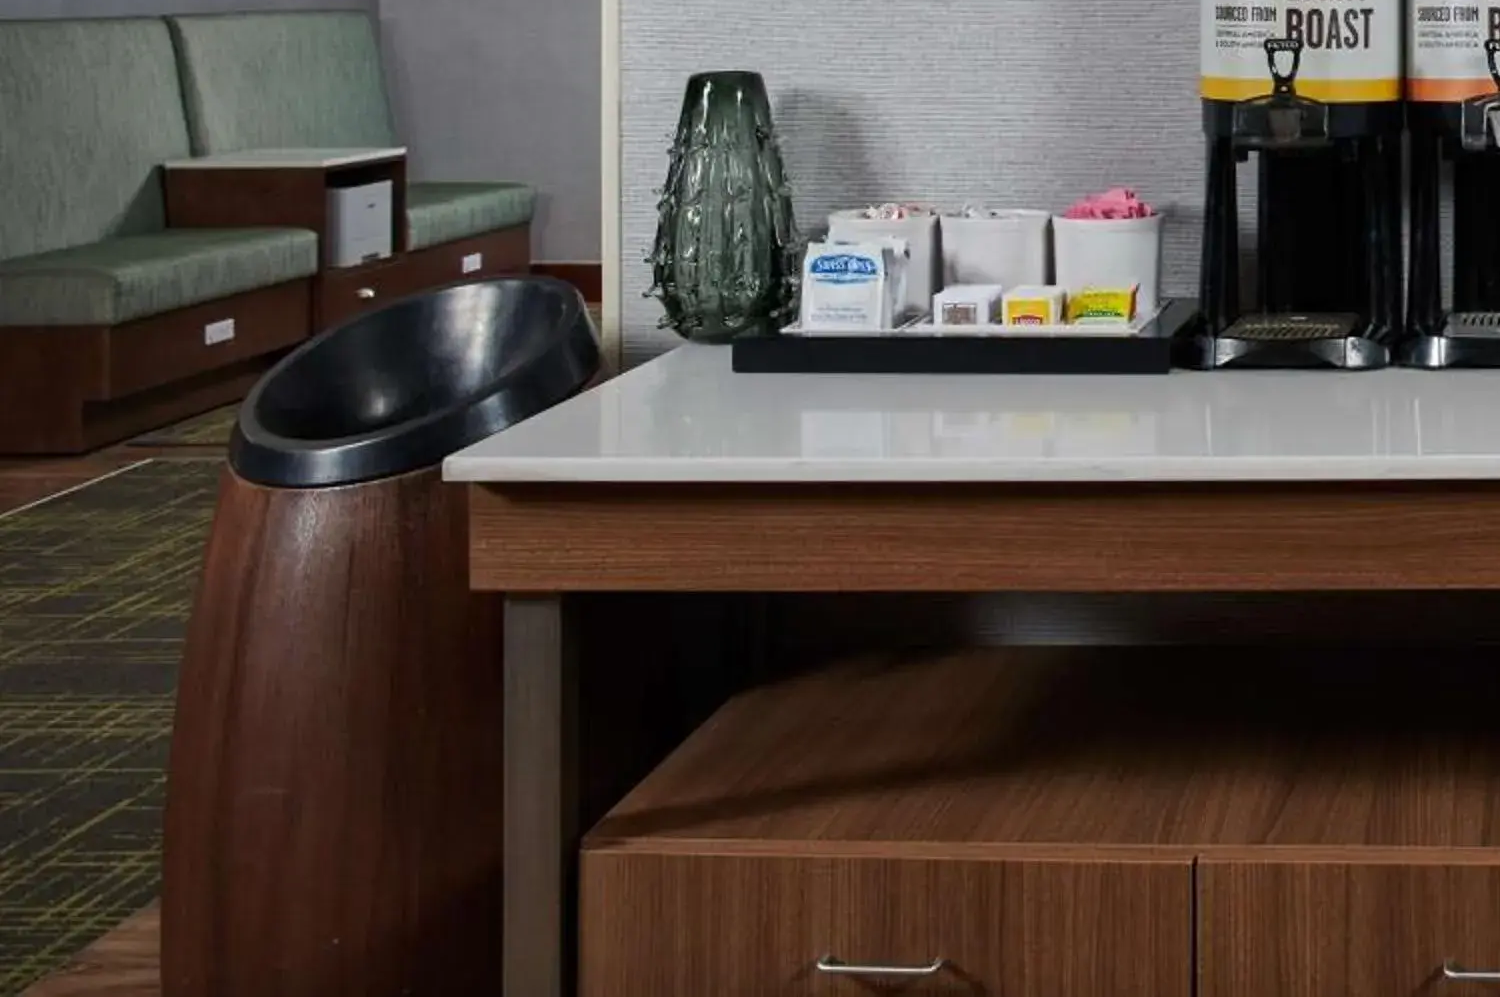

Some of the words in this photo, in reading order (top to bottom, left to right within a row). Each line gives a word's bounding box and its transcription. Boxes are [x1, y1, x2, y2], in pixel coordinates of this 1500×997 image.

[1251, 6, 1277, 22] FROM
[1453, 6, 1479, 22] FROM
[1286, 8, 1374, 50] ROAST
